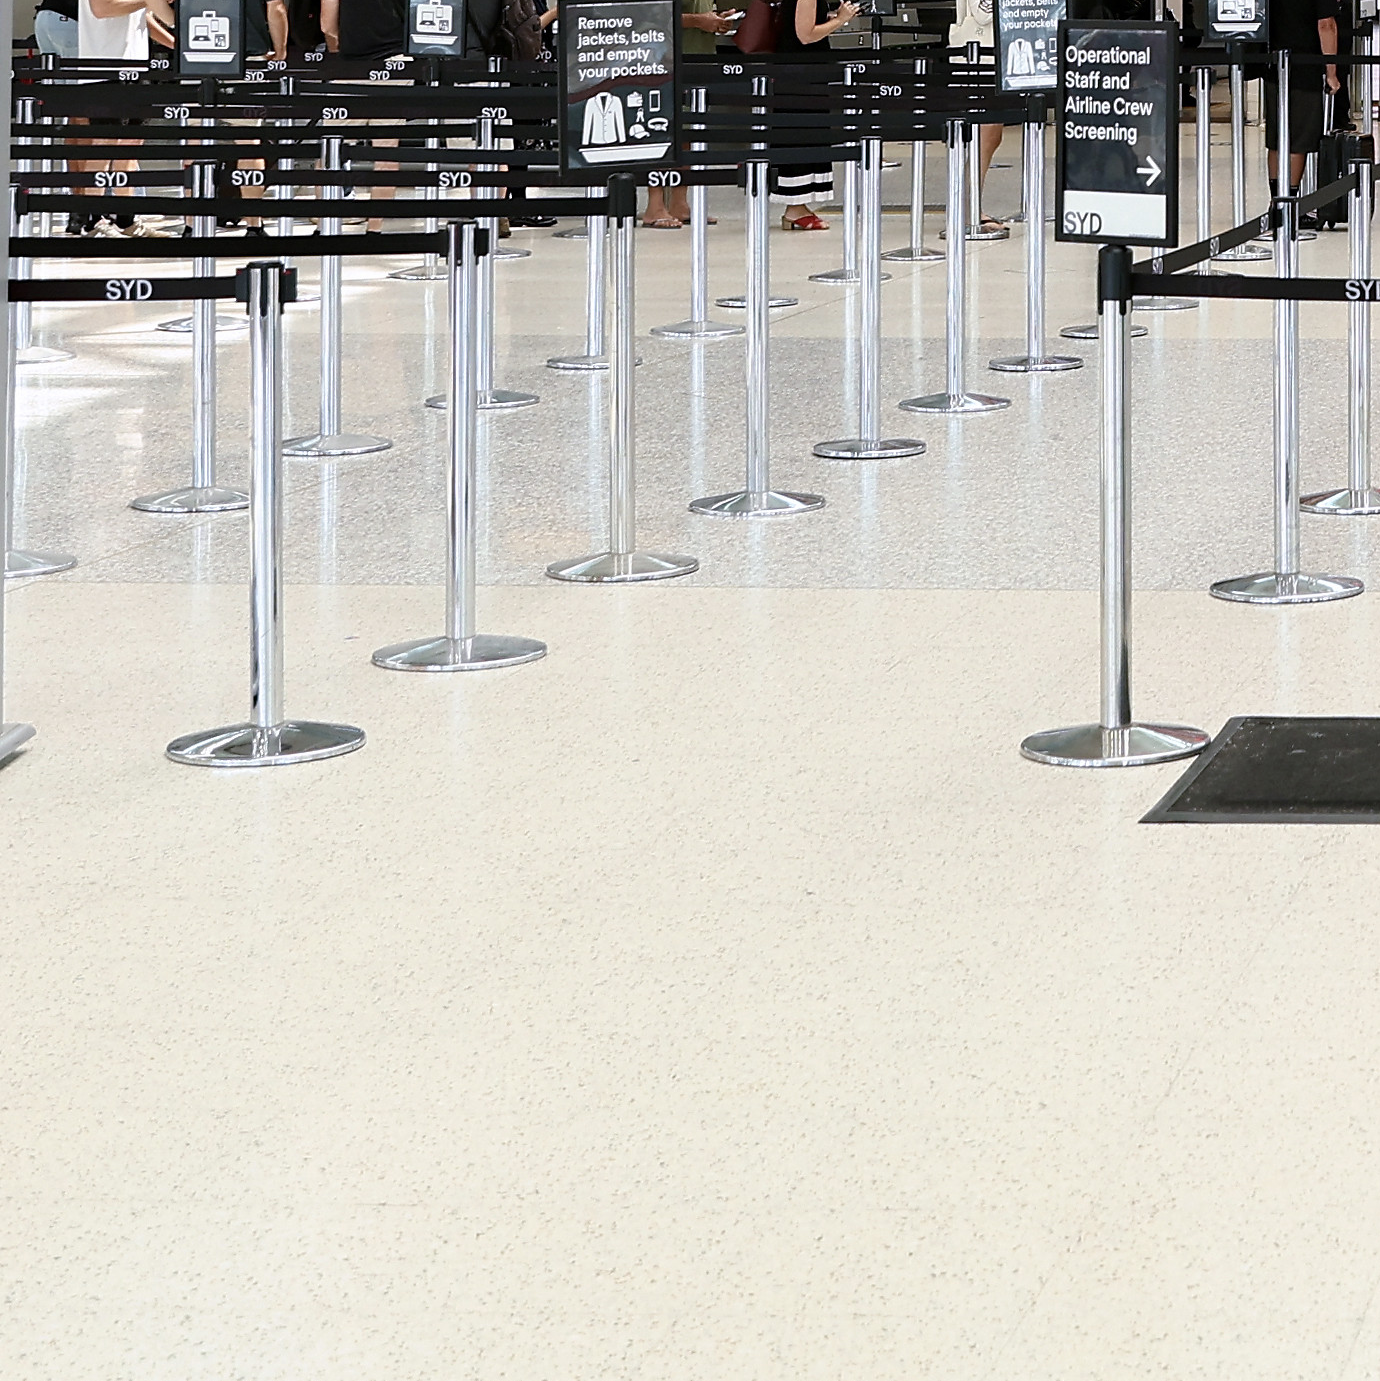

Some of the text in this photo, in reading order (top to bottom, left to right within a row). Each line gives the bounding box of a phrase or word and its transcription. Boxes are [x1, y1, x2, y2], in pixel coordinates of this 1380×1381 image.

[578, 17, 632, 29] Remove
[577, 30, 665, 50] jackets, belts
[577, 47, 650, 64] and empty
[1066, 45, 1150, 66] Operational
[578, 61, 668, 81] your pockets.
[1066, 71, 1130, 89] Staff and
[880, 86, 901, 96] SYD
[164, 107, 189, 119] SYD
[323, 108, 350, 120] SYD
[1065, 96, 1153, 115] Airline Crew
[1065, 121, 1137, 145] Screening
[93, 172, 130, 189] SYD
[438, 172, 474, 189] SYD
[649, 171, 681, 186] SYD
[1064, 212, 1102, 235] SYD
[103, 280, 154, 302] SYD
